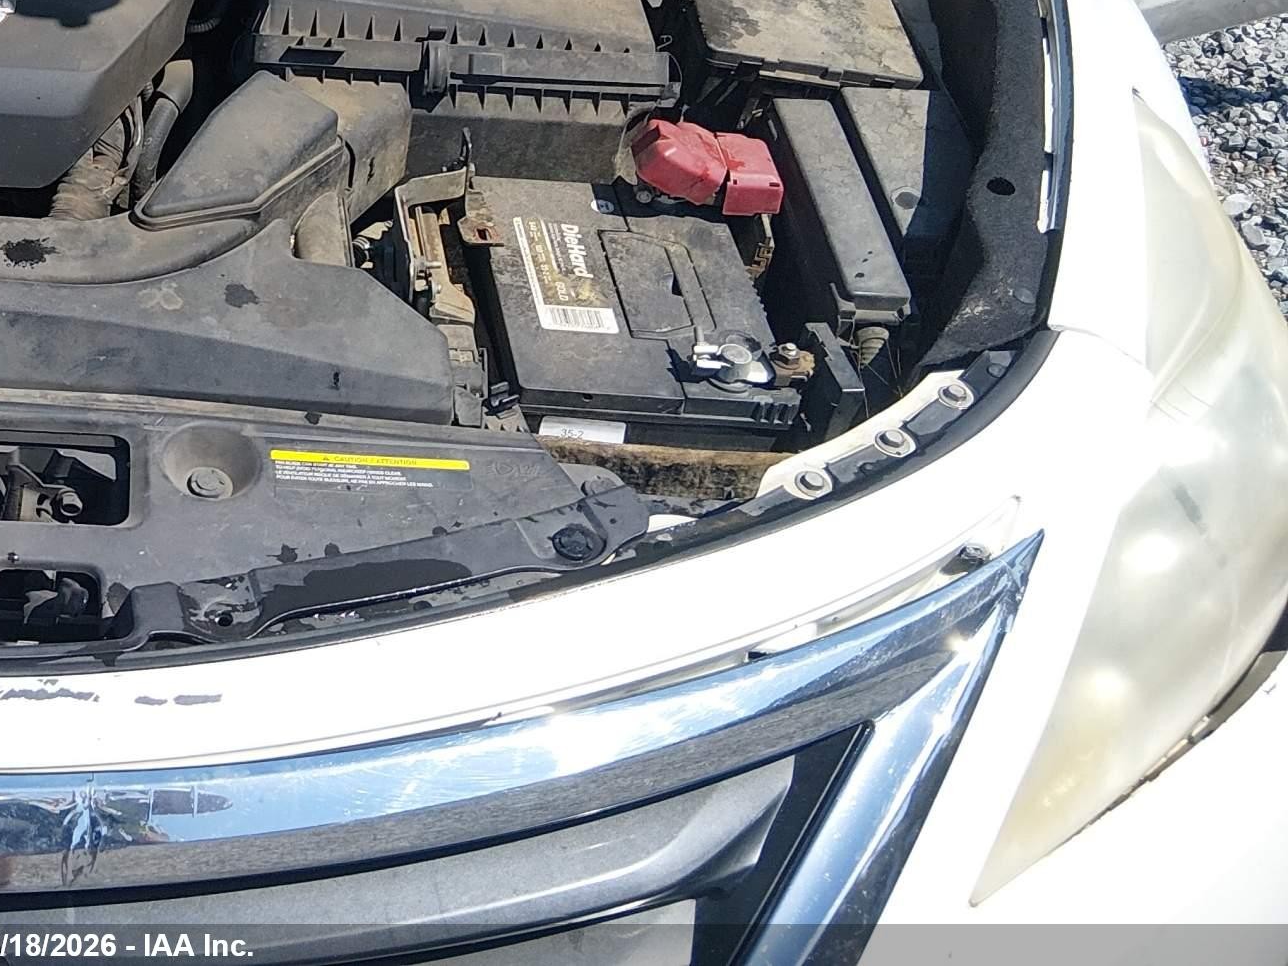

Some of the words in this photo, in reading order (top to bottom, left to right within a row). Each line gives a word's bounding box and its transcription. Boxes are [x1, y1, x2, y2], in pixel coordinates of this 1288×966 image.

[561, 223, 594, 279] DieHard
[555, 281, 569, 301] GOLD
[334, 456, 368, 464] CAUTION
[376, 458, 417, 466] ATTENTION
